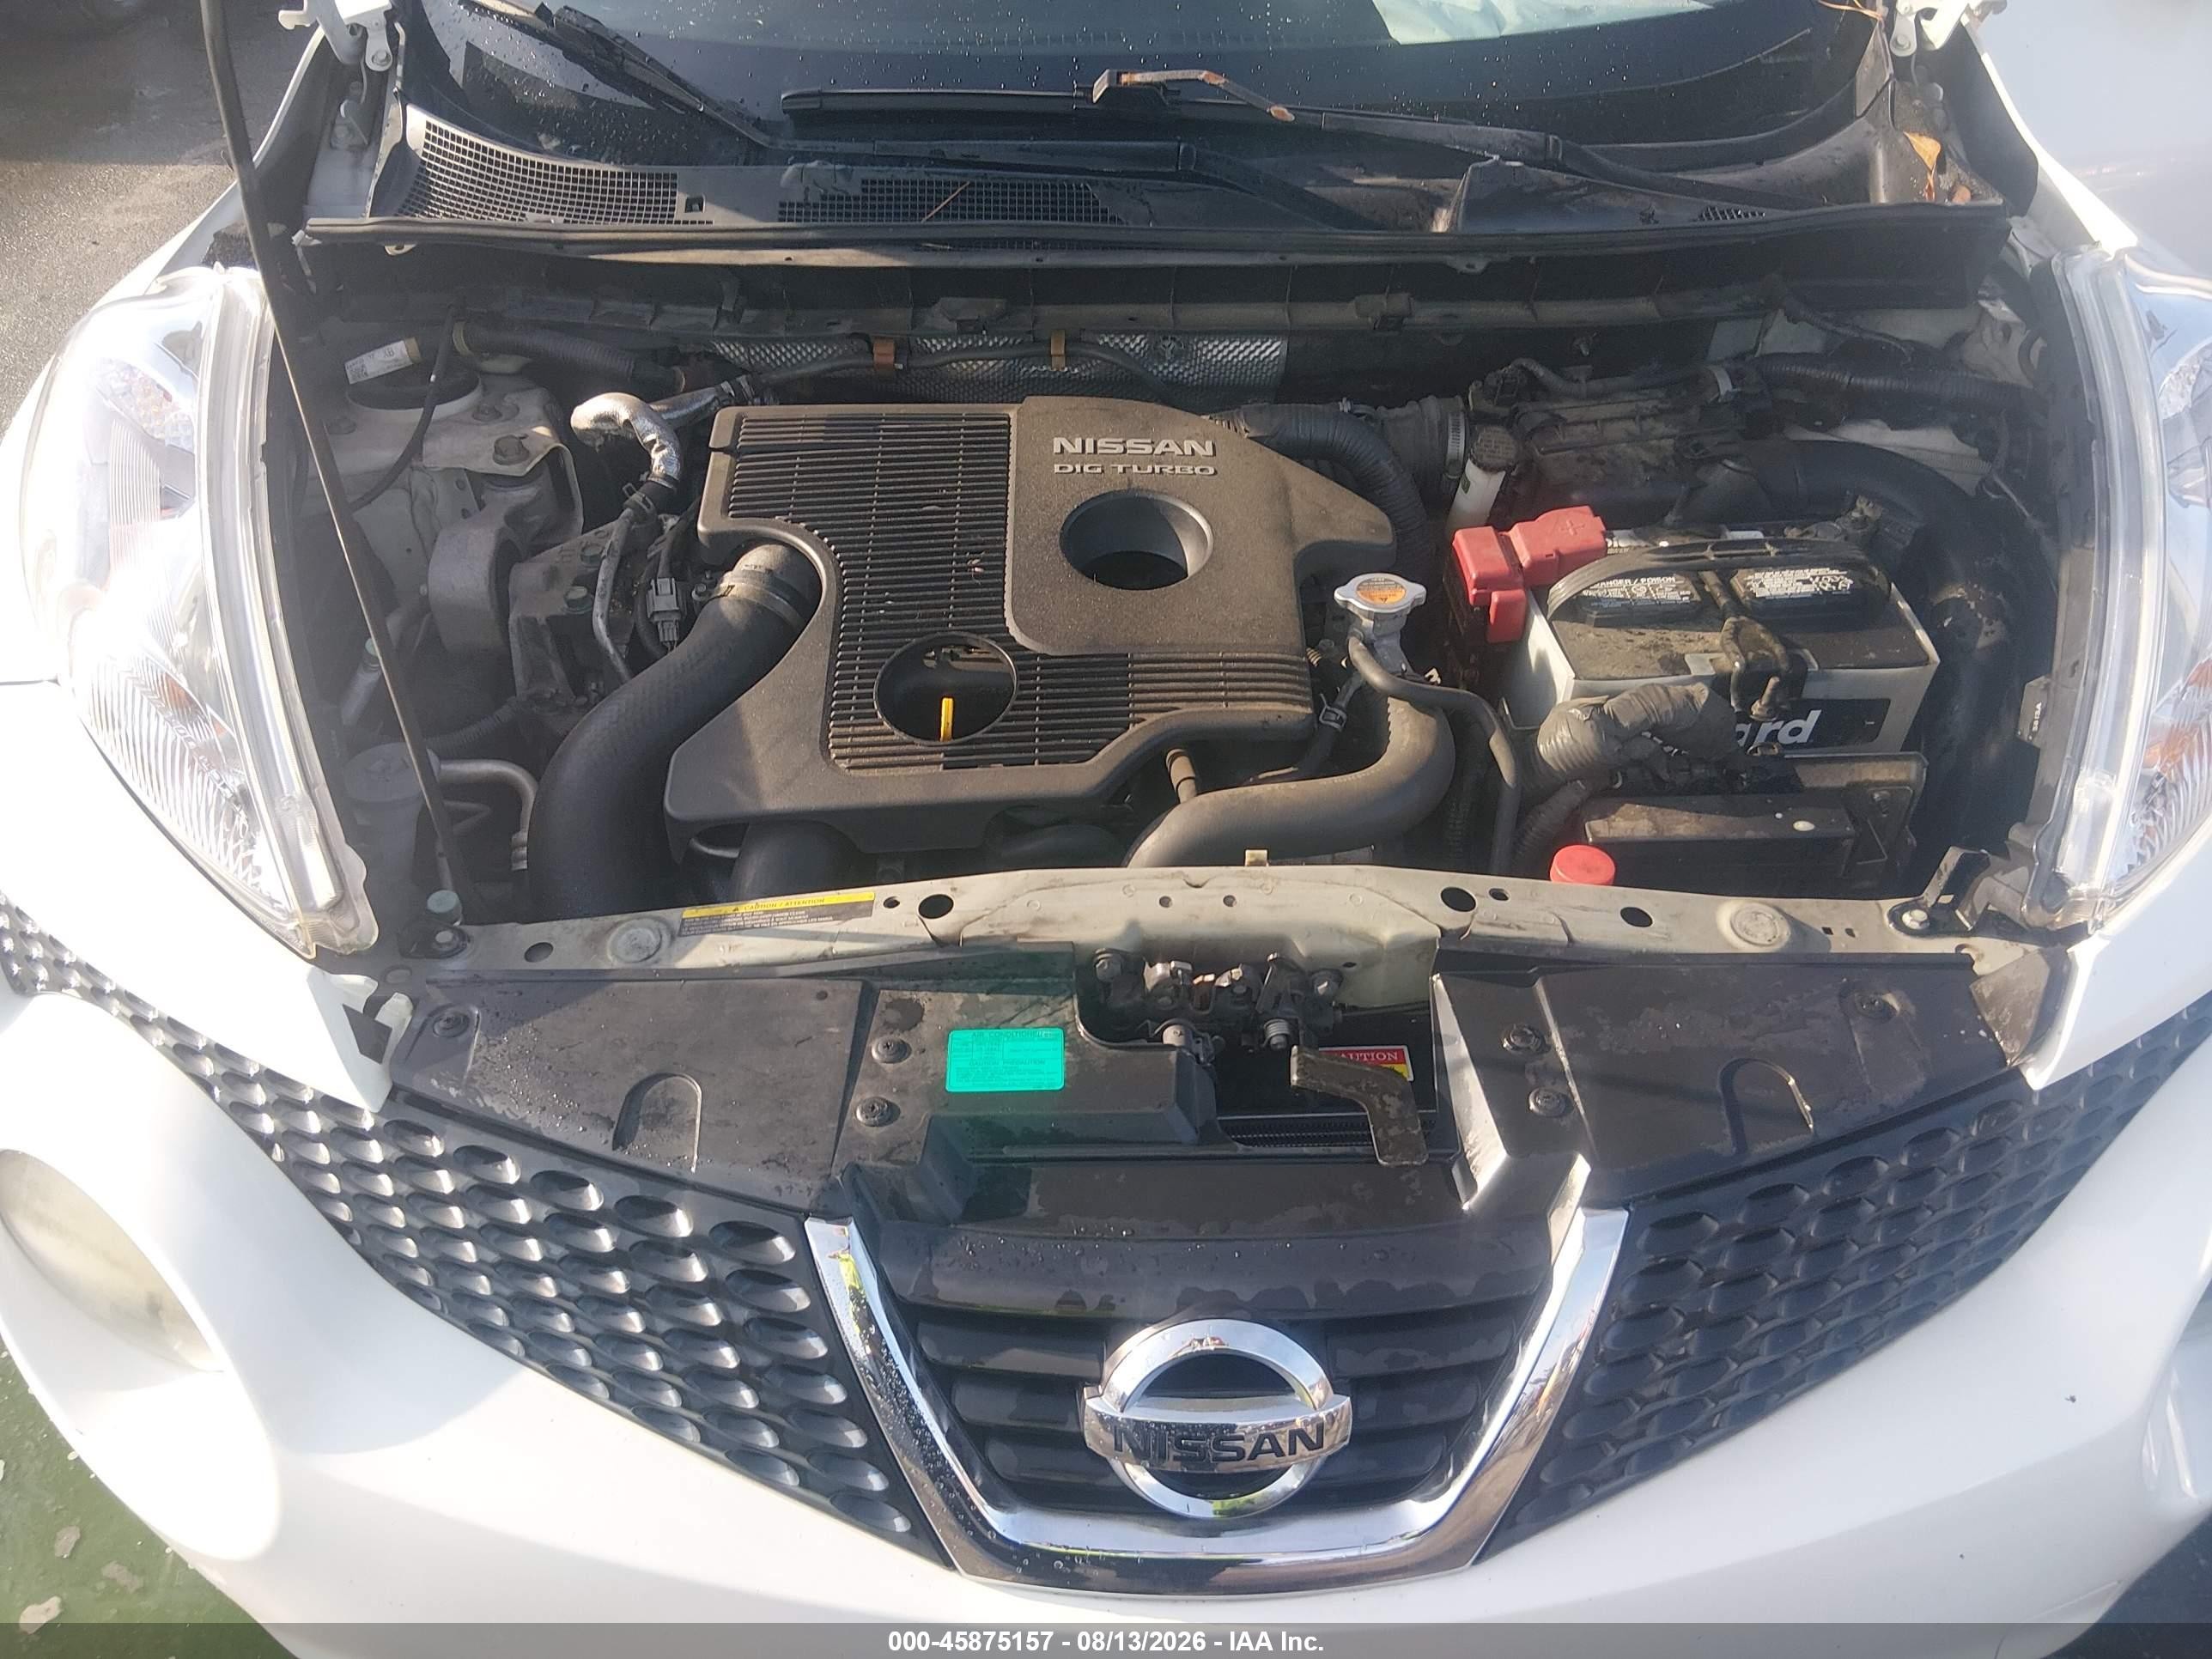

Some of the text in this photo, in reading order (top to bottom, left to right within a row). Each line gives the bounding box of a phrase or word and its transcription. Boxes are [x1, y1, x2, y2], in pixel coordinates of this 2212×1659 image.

[1053, 437, 1216, 457] NISSAN
[1054, 463, 1218, 476] DIG TURBO
[784, 898, 825, 907] ATTENTION
[1113, 1421, 1325, 1464] NISSAN
